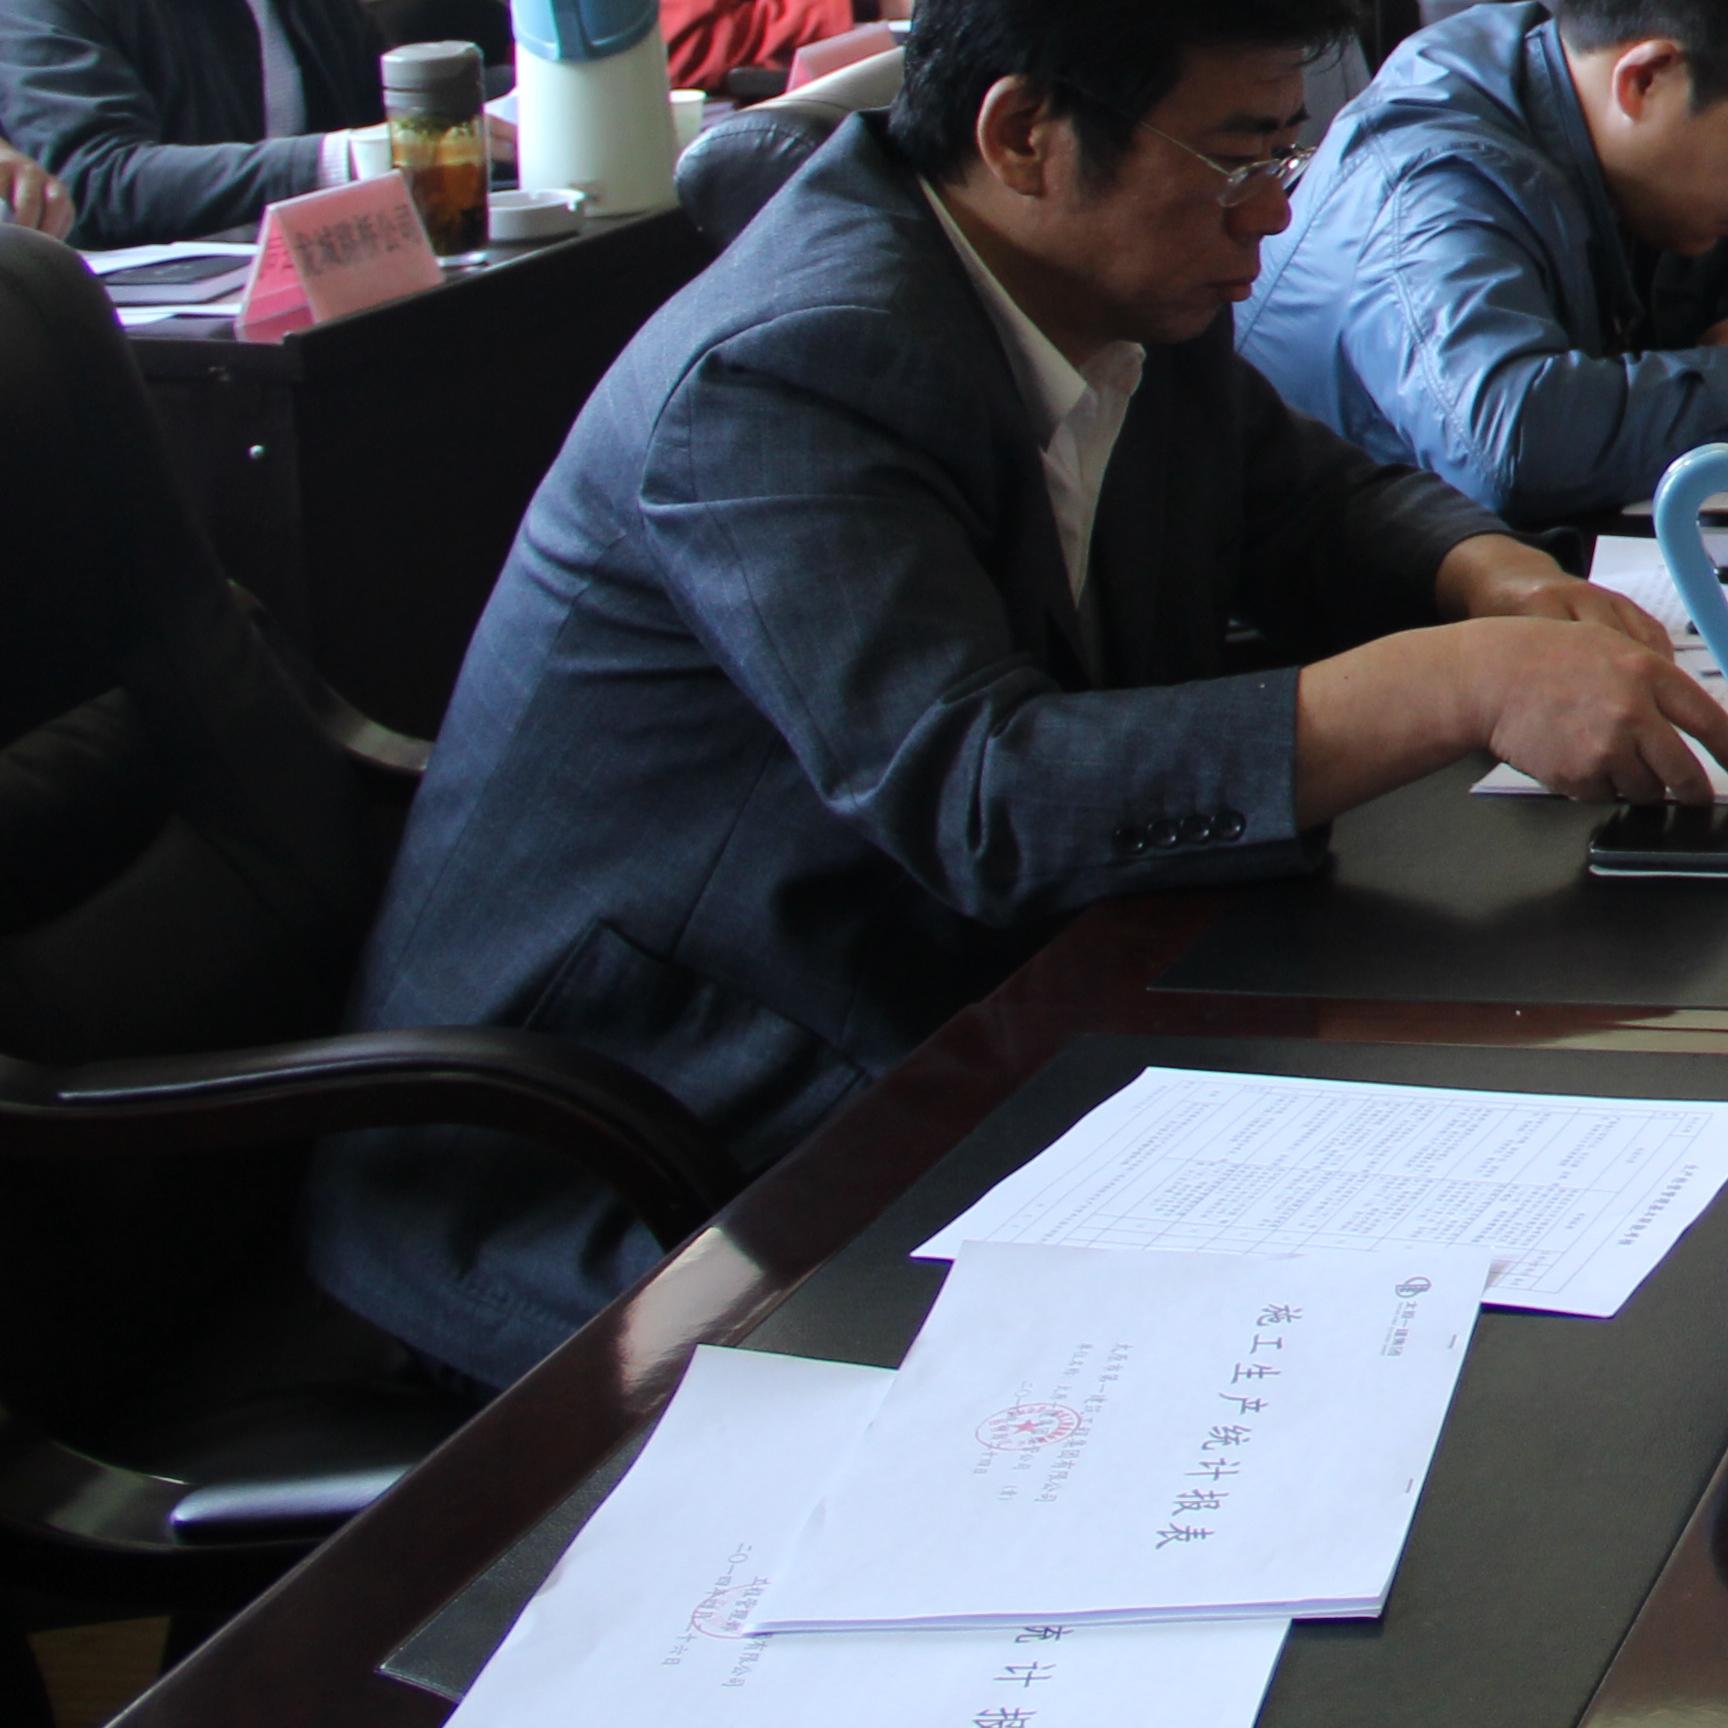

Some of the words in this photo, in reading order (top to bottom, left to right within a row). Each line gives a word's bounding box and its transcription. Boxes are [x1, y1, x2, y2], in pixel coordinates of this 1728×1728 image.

[1155, 1303, 1304, 1550] 施工生产统计报表
